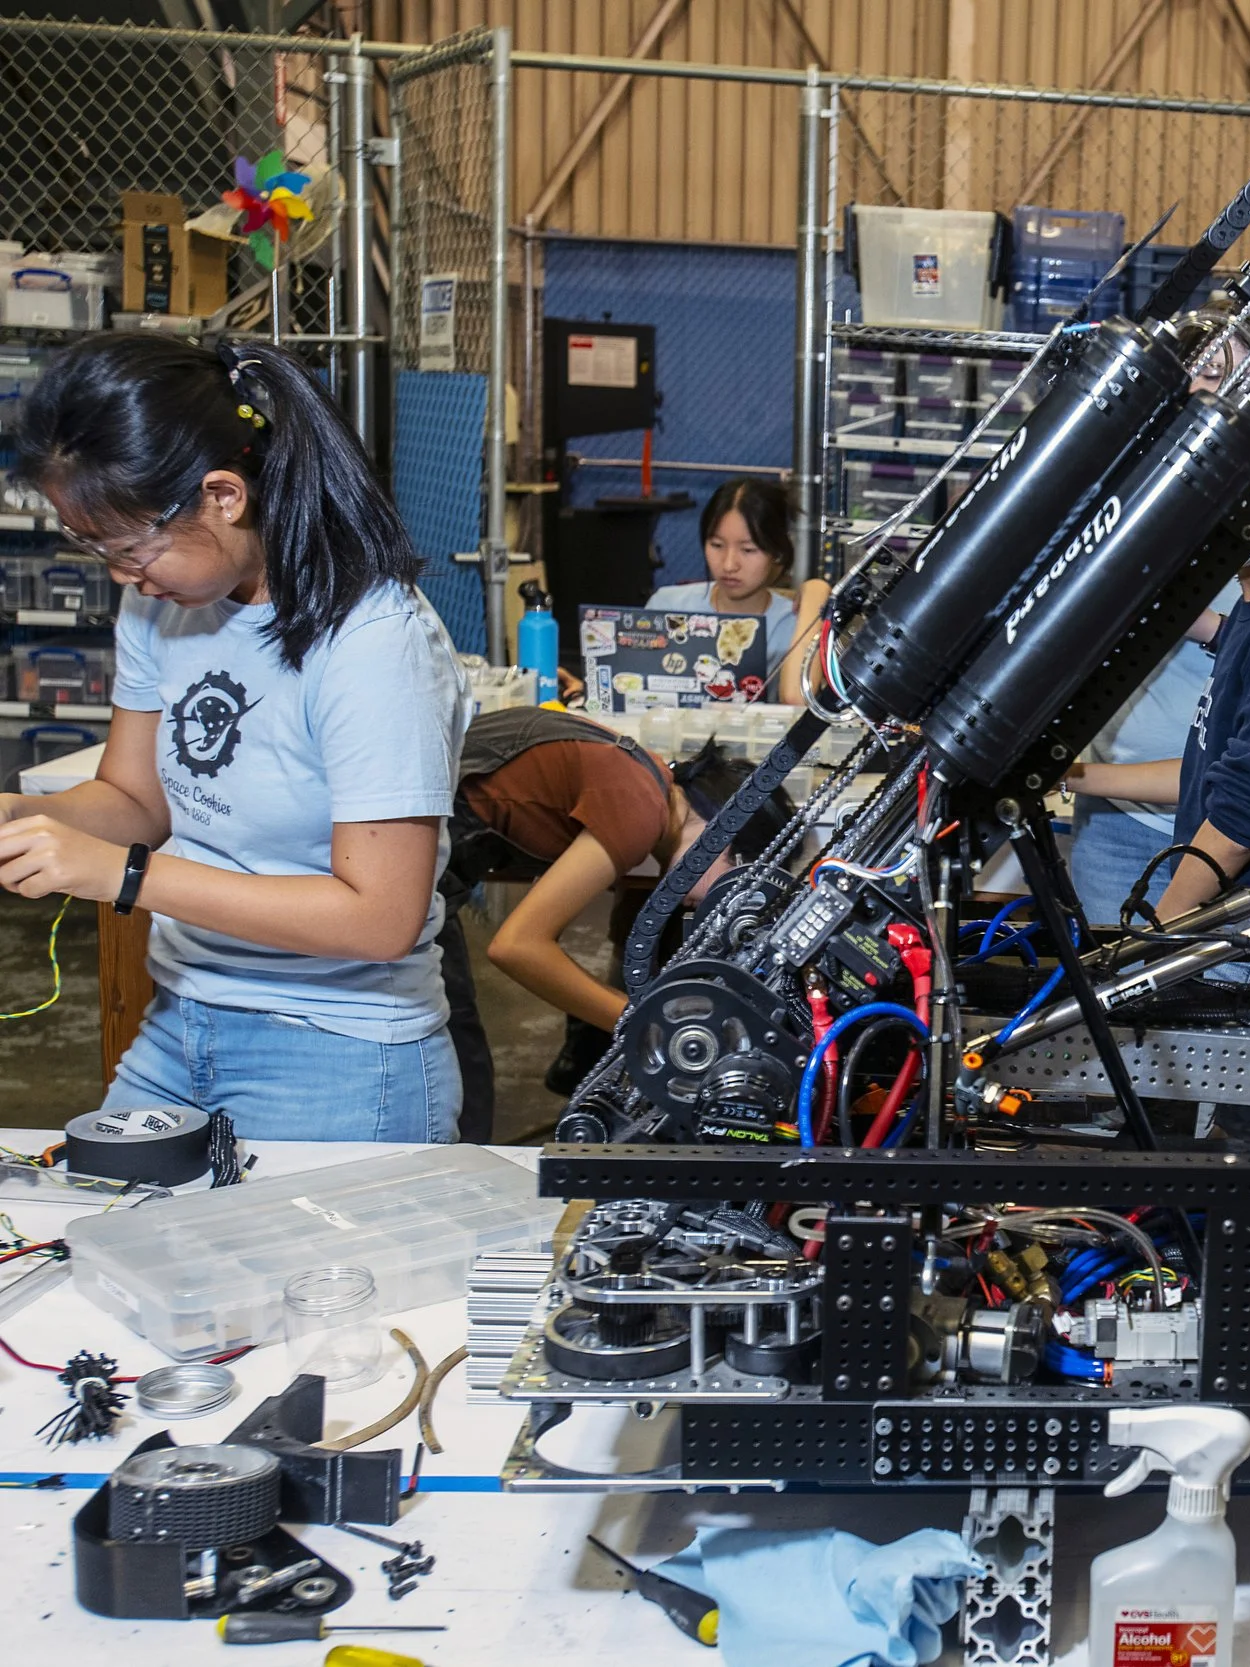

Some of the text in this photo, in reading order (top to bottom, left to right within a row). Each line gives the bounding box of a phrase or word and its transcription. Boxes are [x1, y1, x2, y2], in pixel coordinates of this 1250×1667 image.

[1004, 495, 1122, 645] Clippard
[665, 652, 684, 674] hp
[161, 768, 190, 797] Space
[193, 786, 233, 817] Cookies
[191, 807, 212, 826] 1868
[701, 1124, 769, 1142] TALON FX
[1119, 1632, 1171, 1646] Alcohol
